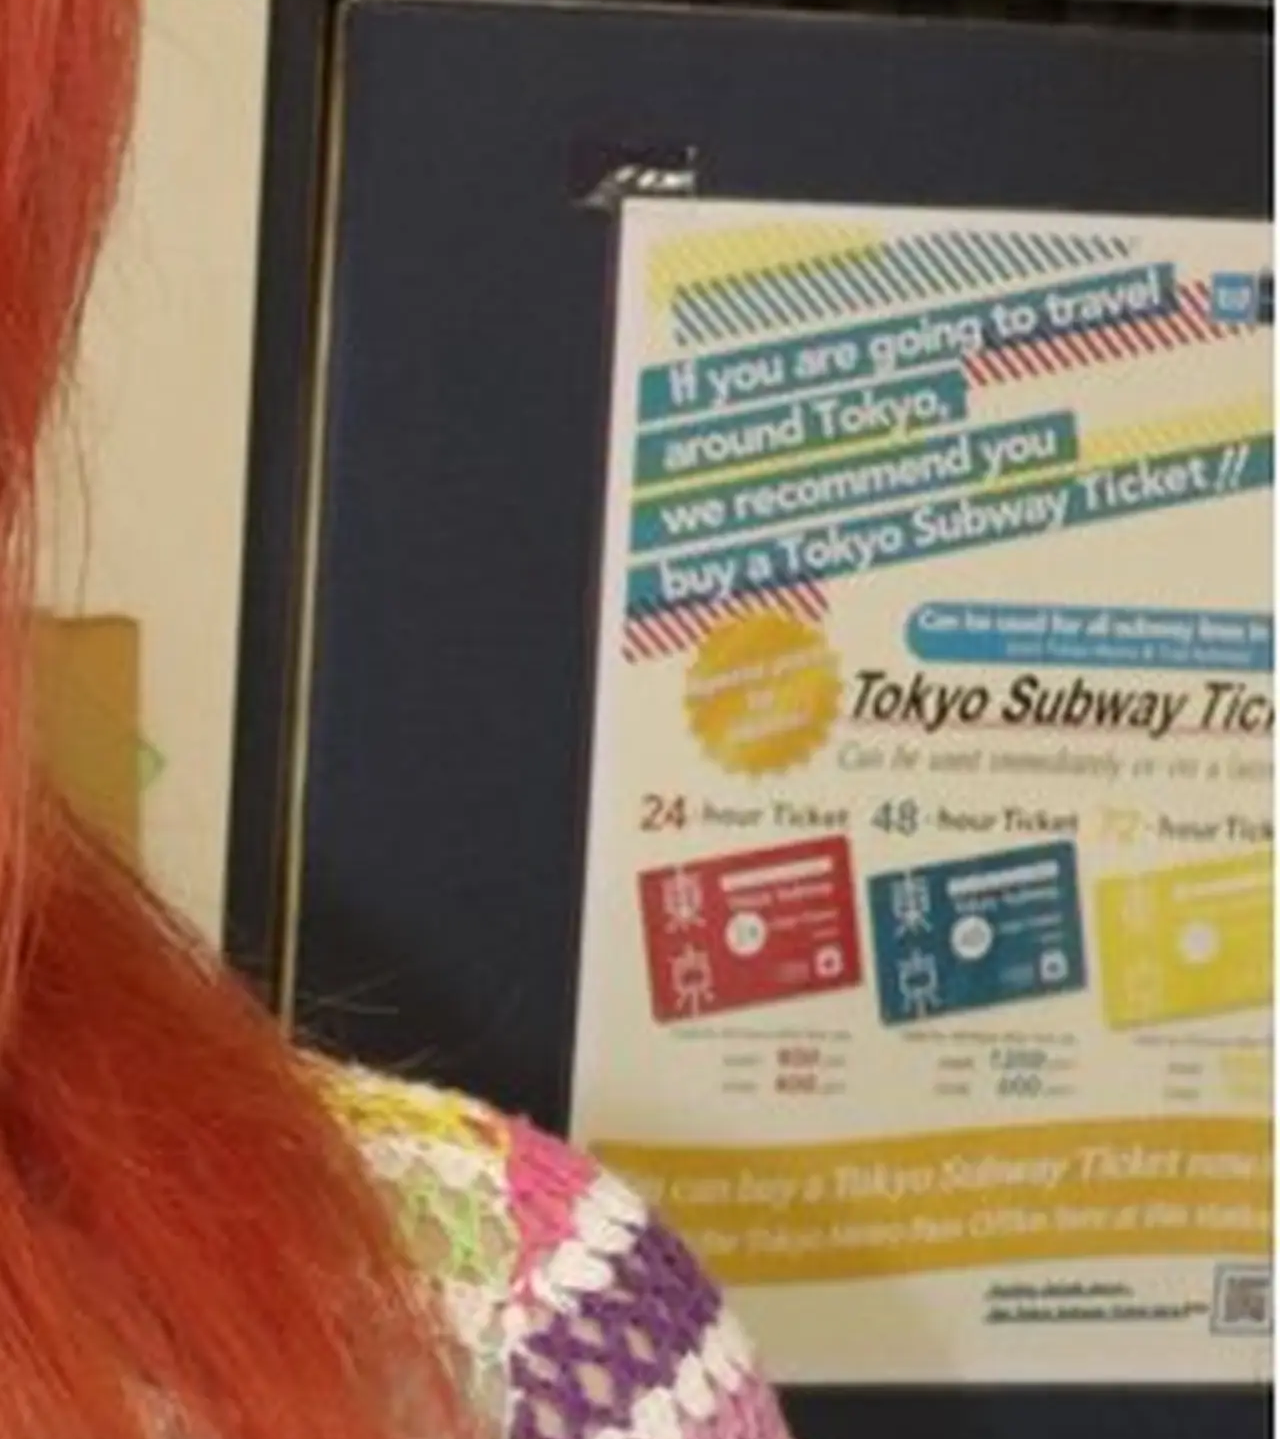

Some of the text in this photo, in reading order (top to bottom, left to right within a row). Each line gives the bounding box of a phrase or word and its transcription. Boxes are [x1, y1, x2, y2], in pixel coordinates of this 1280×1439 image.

[669, 360, 697, 406] If
[708, 355, 784, 406] you
[795, 341, 858, 376] are
[869, 313, 982, 374] going
[992, 302, 1036, 337] to
[1045, 265, 1161, 324] travel
[664, 407, 805, 472] around
[662, 429, 1056, 535] we recommend you
[659, 558, 737, 603] buy
[746, 551, 772, 581] a
[776, 522, 903, 572] Tokyo
[912, 489, 1070, 547] Subway
[852, 670, 990, 733] Tokyo
[1002, 673, 1190, 739] Subway
[772, 799, 849, 828] Ticket
[1003, 804, 1078, 833] Ticket
